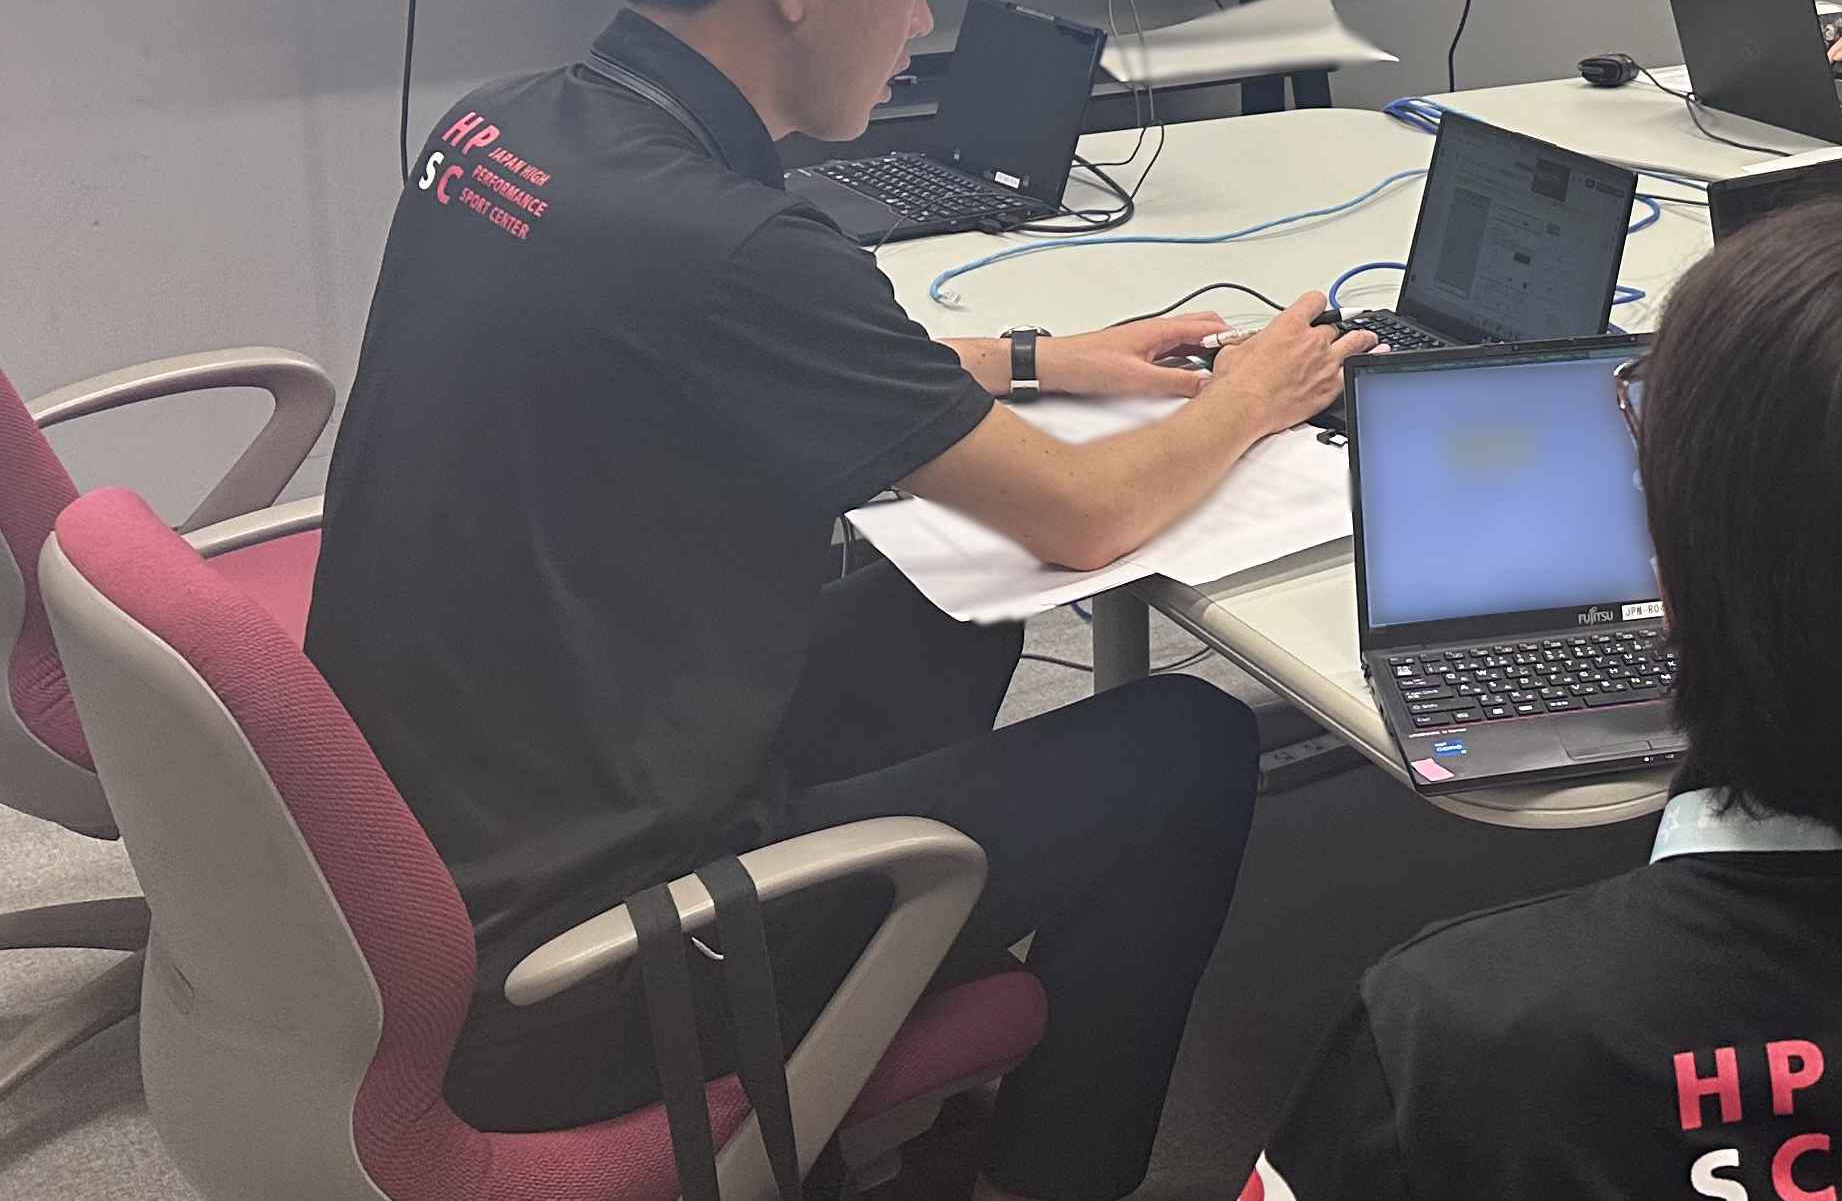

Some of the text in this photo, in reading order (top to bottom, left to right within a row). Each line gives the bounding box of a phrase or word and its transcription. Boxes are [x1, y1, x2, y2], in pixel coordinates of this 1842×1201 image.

[441, 111, 500, 155] HP
[418, 151, 464, 205] SC
[471, 164, 549, 218] PERFORMANCE
[487, 146, 551, 187] JAPAN HIGH
[459, 187, 531, 241] SPORT CENTER
[1673, 1039, 1824, 1131] HP
